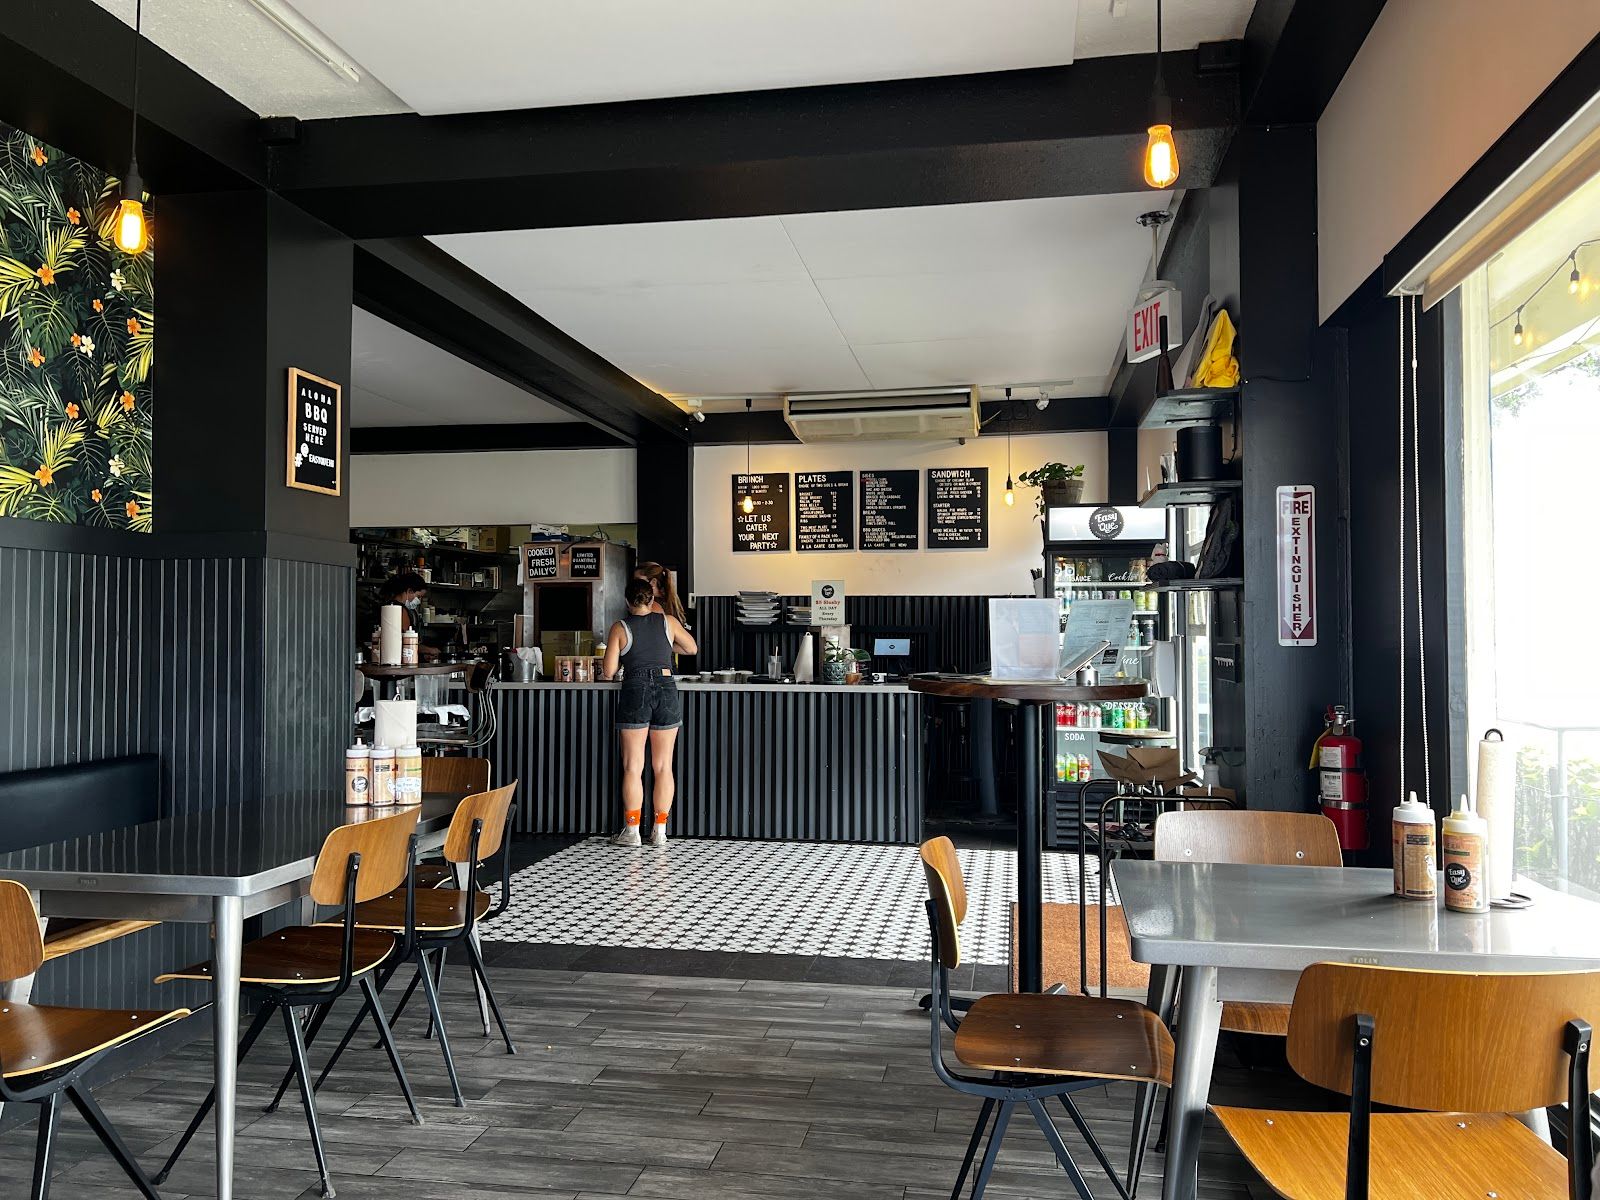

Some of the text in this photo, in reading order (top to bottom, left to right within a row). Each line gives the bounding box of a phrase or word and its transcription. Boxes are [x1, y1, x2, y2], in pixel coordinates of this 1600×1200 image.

[1134, 302, 1160, 352] EXIT
[301, 388, 332, 405] ALOHA
[304, 402, 328, 424] BBQ
[303, 422, 327, 437] SERVED
[305, 432, 324, 446] HERE
[738, 475, 764, 483] BRUNCH
[799, 475, 826, 483] PLATES
[931, 470, 970, 478] SANDWICH
[1282, 500, 1309, 514] FIRE
[1095, 513, 1117, 523] Easy
[528, 548, 554, 557] COOKED
[532, 558, 555, 567] FRESH
[529, 567, 549, 576] DAILY
[1291, 517, 1302, 631] EXTINGUISHER
[1104, 702, 1145, 712] DESSERT
[1448, 869, 1466, 877] Easy
